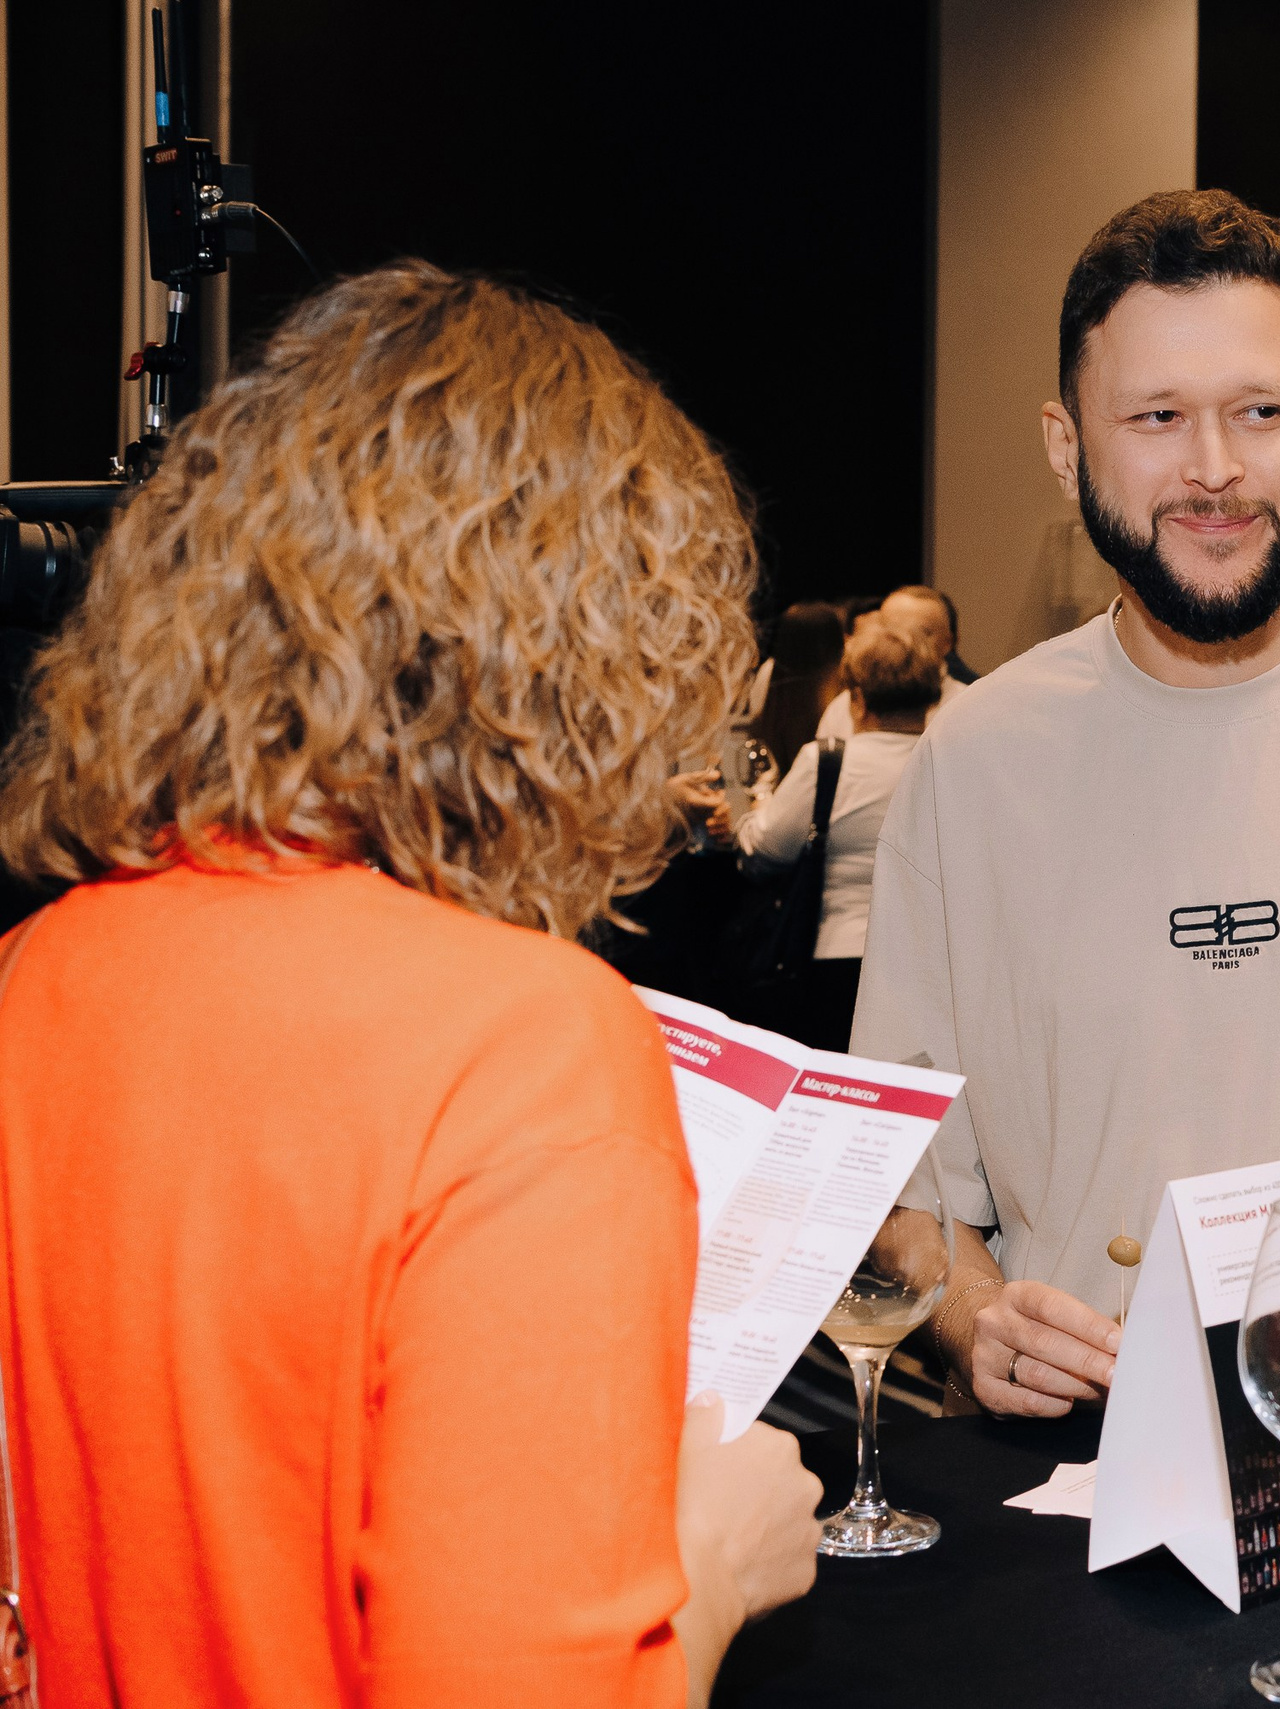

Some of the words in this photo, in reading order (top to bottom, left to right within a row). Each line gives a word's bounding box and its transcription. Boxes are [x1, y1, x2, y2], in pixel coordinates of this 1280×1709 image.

[1192, 946, 1260, 961] BALENCIAGA
[1212, 960, 1240, 970] PARIS
[801, 1077, 881, 1103] Мастер-классы
[1243, 1185, 1262, 1195] выбор
[1199, 1209, 1257, 1229] Коллекция
